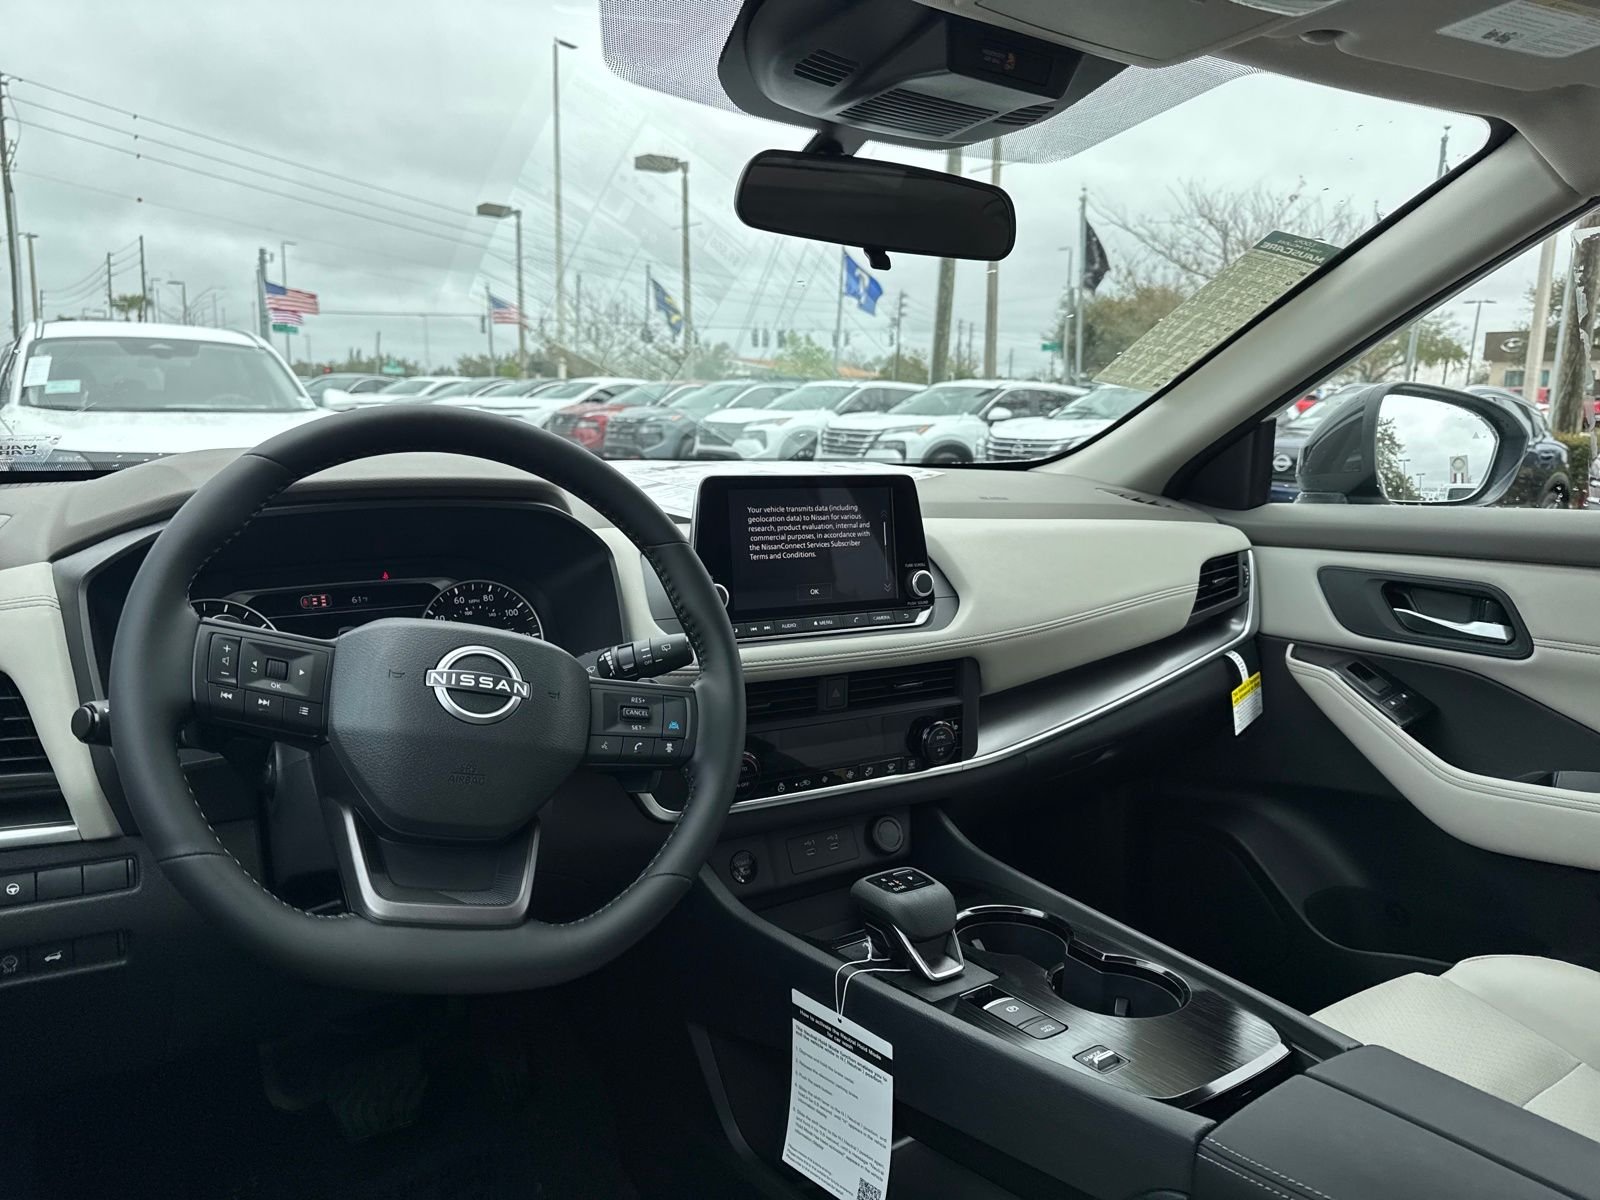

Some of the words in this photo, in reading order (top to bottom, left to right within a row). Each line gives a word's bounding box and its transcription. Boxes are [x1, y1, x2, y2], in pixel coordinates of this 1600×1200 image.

[748, 516, 785, 524] geolocation
[787, 533, 815, 541] purposes,
[454, 596, 465, 604] 60
[270, 682, 282, 690] OK
[430, 673, 527, 695] NISSAN
[814, 1017, 831, 1032] activate
[839, 1031, 856, 1046] Neutral
[856, 1041, 867, 1052] Hold
[868, 1048, 881, 1061] Mode
